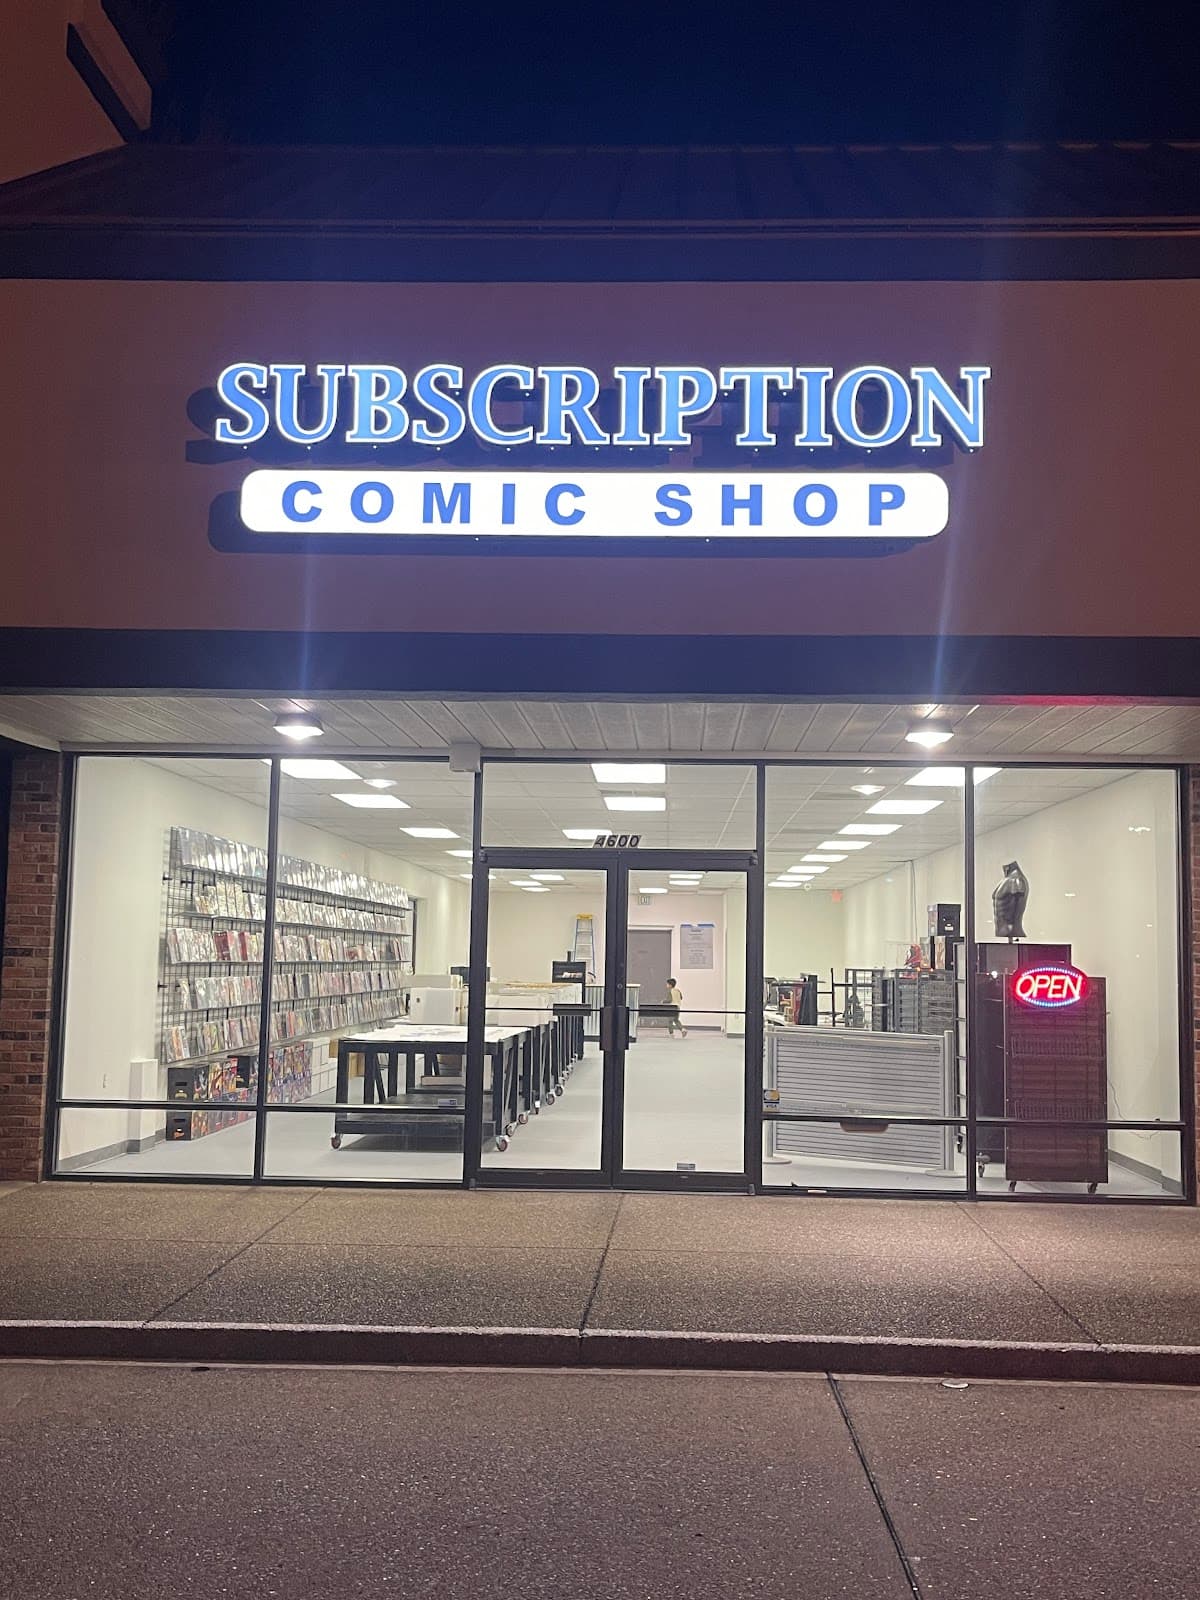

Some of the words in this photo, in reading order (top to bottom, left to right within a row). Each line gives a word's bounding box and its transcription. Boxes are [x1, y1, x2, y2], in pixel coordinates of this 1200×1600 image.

[214, 362, 992, 449] SUBSCRIPTION
[281, 480, 586, 527] COMIC
[653, 482, 906, 528] SHOP
[593, 835, 641, 848] 4600
[1015, 974, 1083, 999] OPEN
